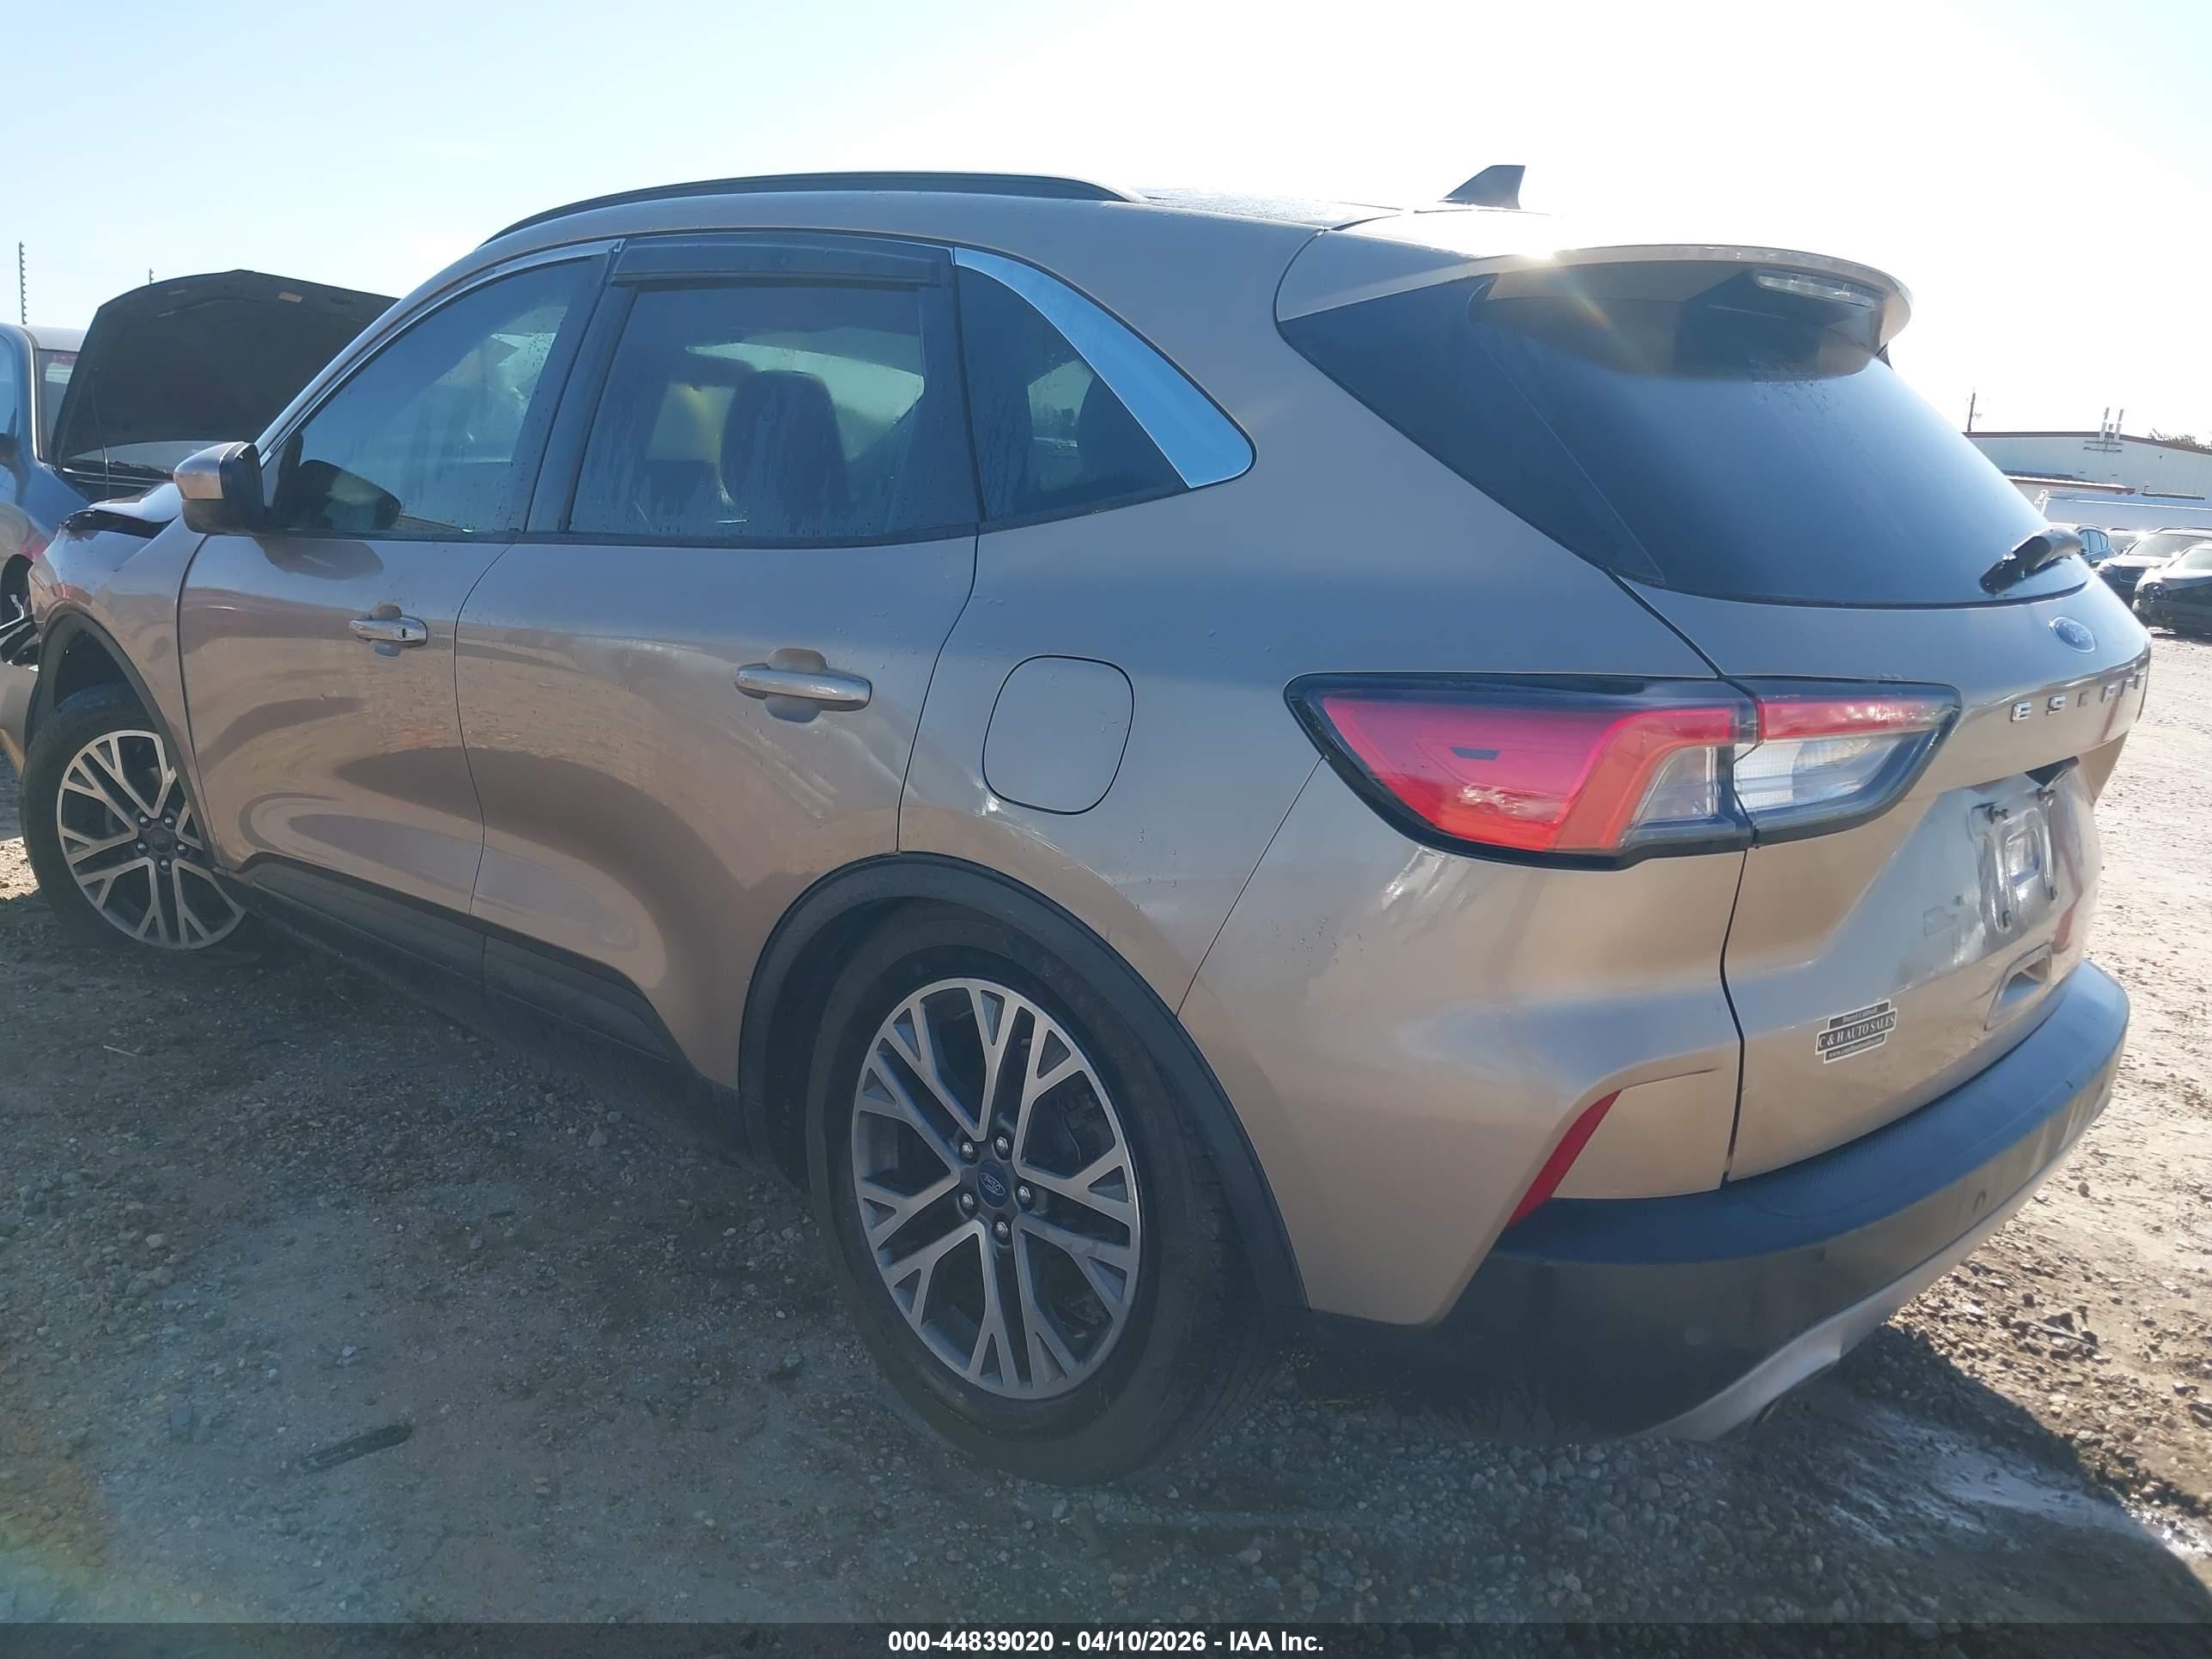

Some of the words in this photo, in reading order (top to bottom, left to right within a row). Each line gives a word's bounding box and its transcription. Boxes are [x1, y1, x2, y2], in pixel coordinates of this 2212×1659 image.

[1818, 1036, 1826, 1048] C
[1826, 1033, 1835, 1047] &
[1836, 1030, 1844, 1044] H
[1844, 1023, 1869, 1042] AUTO
[1869, 1015, 1895, 1033] SALES
